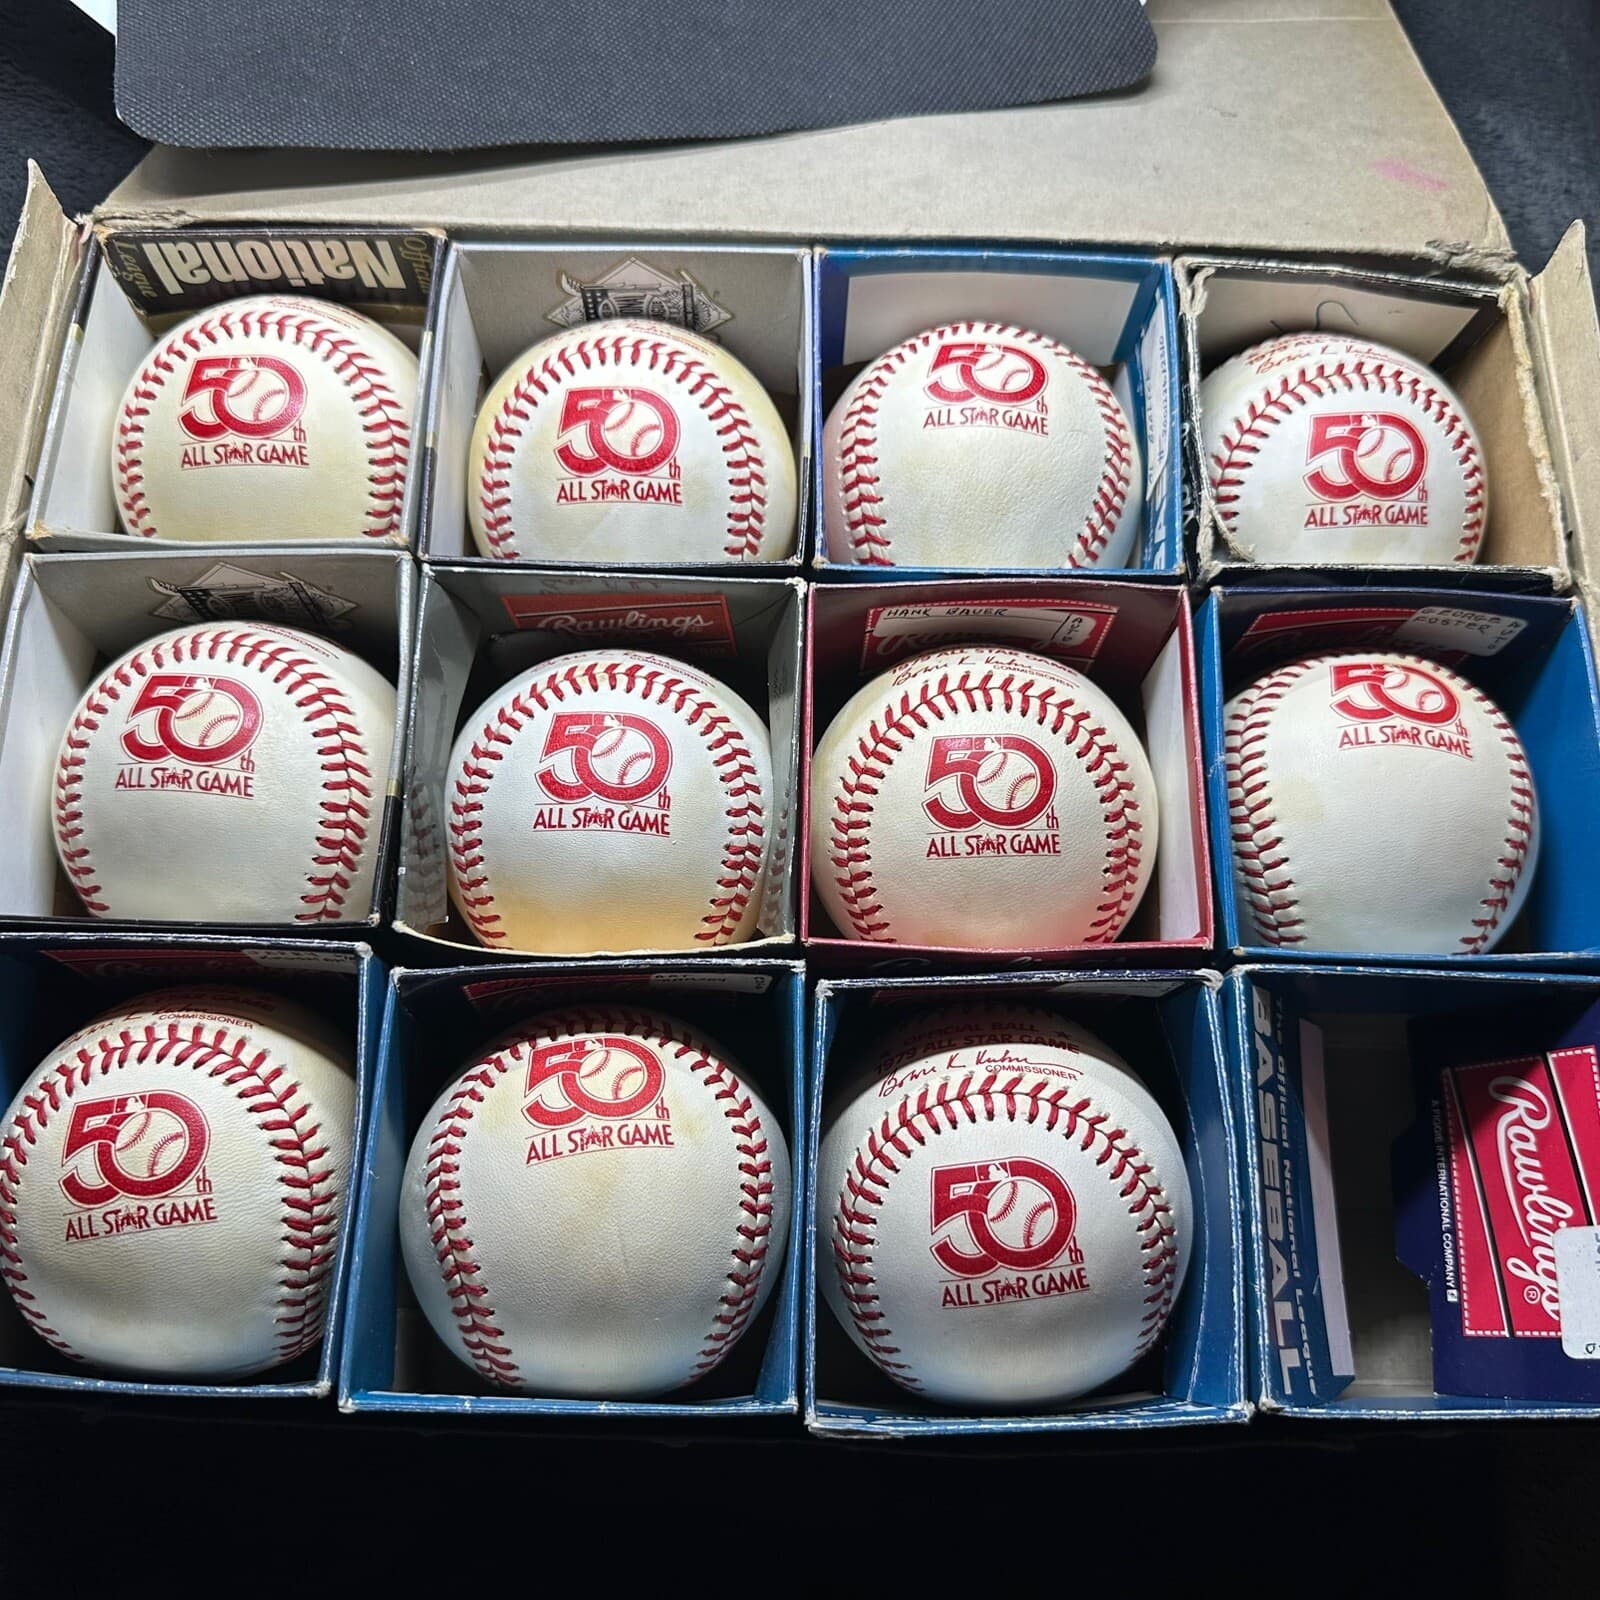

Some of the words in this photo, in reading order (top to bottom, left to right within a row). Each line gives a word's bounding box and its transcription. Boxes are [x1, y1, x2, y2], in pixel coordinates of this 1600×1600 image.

[144, 239, 407, 294] National
[923, 408, 956, 429] ALL
[960, 405, 999, 426] STAR
[1002, 410, 1049, 435] GAME
[181, 445, 211, 468] ALL
[213, 442, 253, 465] STAR
[257, 443, 309, 467] GAME
[557, 483, 587, 503] ALL
[591, 478, 630, 501] STAR
[633, 480, 682, 503] GAME
[1305, 506, 1338, 528] ALL
[1343, 504, 1381, 525] STAR
[1385, 504, 1428, 525] GAME
[537, 610, 714, 637] Rawlings
[887, 608, 931, 617] HANK
[945, 608, 1008, 617] BAUER
[1413, 615, 1490, 634] FOSTER
[1338, 726, 1376, 749] ALL
[1380, 724, 1422, 747] STAR
[1425, 727, 1473, 760] GAME
[115, 768, 144, 790] ALL
[150, 766, 193, 790] STAR
[196, 770, 254, 797] GAME
[533, 808, 567, 830] ALL
[572, 806, 614, 829] STAR
[618, 810, 670, 835] GAME
[926, 837, 961, 858] ALL
[965, 833, 1007, 856] STAR
[1010, 833, 1061, 855] GAME
[963, 1033, 1014, 1046] STAR
[1018, 1033, 1081, 1055] GAME
[985, 1064, 1079, 1081] COMMISSIONER
[526, 1137, 564, 1165] ALL
[568, 1125, 614, 1155] STAR
[617, 1124, 675, 1147] GAME
[1251, 985, 1302, 1397] BASEBALL
[1434, 1145, 1452, 1231] INTERNATIONAL
[65, 1217, 99, 1242] ALL
[104, 1207, 151, 1235] STAR
[153, 1198, 218, 1227] GAME
[1440, 1232, 1456, 1288] COMPANY
[941, 1281, 977, 1308] ALL
[981, 1275, 1027, 1304] STAR
[1031, 1267, 1090, 1298] GAME
[1282, 1159, 1301, 1278] National
[1294, 1287, 1318, 1396] League
